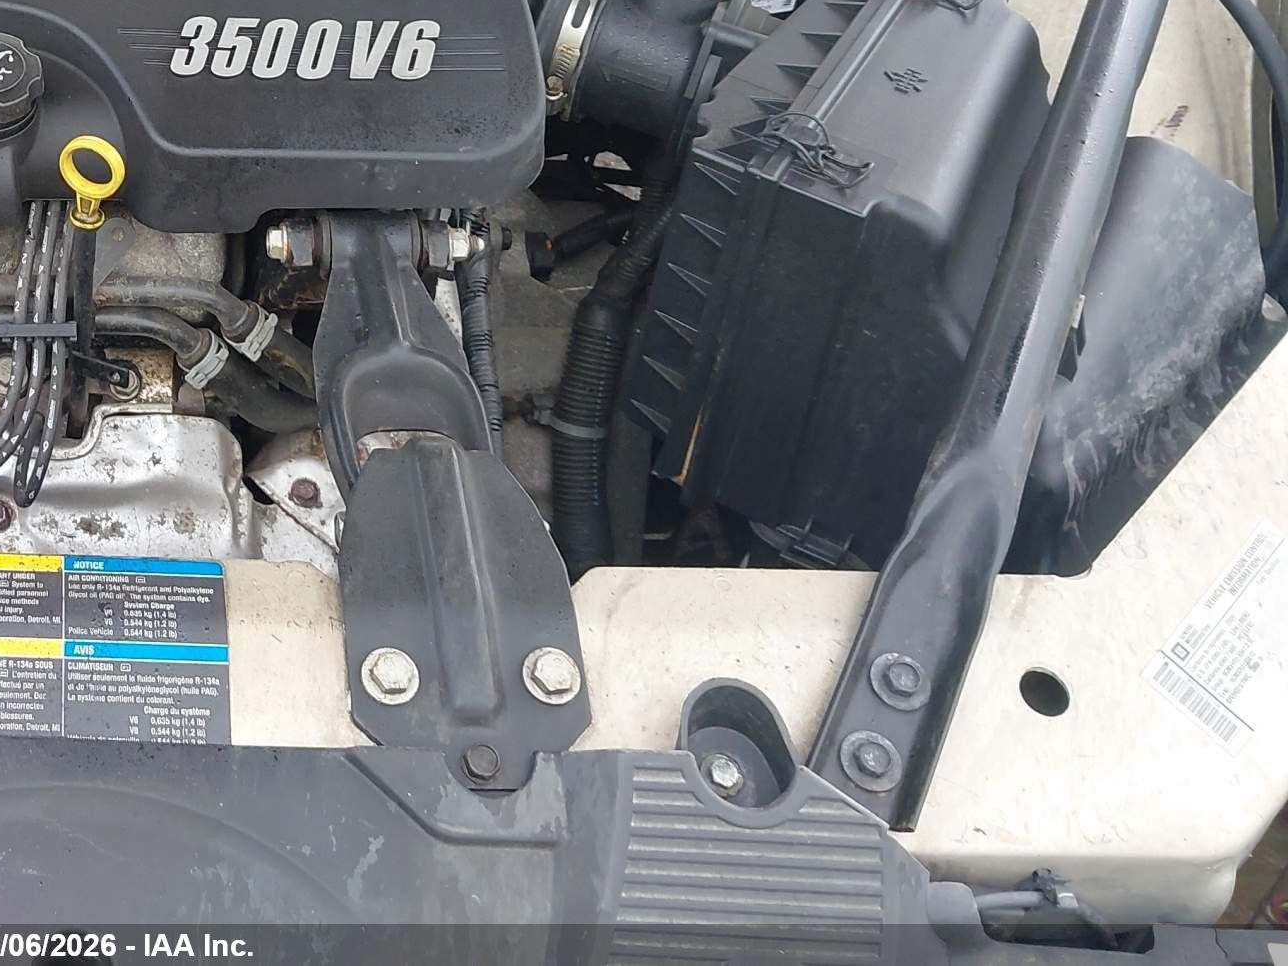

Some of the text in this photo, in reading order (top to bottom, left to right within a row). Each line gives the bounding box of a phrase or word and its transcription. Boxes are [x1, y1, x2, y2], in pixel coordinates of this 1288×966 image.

[169, 15, 441, 81] 3500 V6
[73, 560, 104, 570] NOTICE
[81, 575, 129, 583] CONDITIONING
[82, 584, 96, 592] only
[122, 585, 158, 594] Refrigerant
[173, 586, 214, 595] Polyalkylene
[68, 591, 88, 599] Glycol
[99, 592, 114, 600] (PAG
[143, 594, 167, 602] system
[4, 606, 24, 614] injury.
[124, 601, 175, 611] System Charge
[28, 616, 51, 624] Detroit,
[143, 611, 152, 619] kg
[153, 611, 167, 619] (1.4
[168, 611, 177, 619] lb)
[123, 619, 177, 629] 0.544 kg (1.2 lb)
[68, 627, 178, 639] Police Vehicle 0.544 kg (1.2 lb)
[73, 645, 95, 655] AVIS
[8, 660, 33, 669] R-134a
[35, 661, 53, 669] SOUS
[67, 661, 114, 672] CLIMATISEUR
[48, 672, 57, 680] du
[67, 672, 220, 686] Utiliser seulement fluide frigorigène R-134a
[23, 682, 34, 690] par
[181, 687, 200, 696] (huile
[201, 688, 219, 697] PAG).
[107, 695, 135, 703] contient
[6, 701, 44, 710] incorrectes
[143, 705, 210, 716] Charge du système
[0, 712, 34, 720] blessures.
[26, 722, 50, 732] Detroit,
[171, 718, 206, 728] kg lb)
[171, 728, 206, 738] kg lb)
